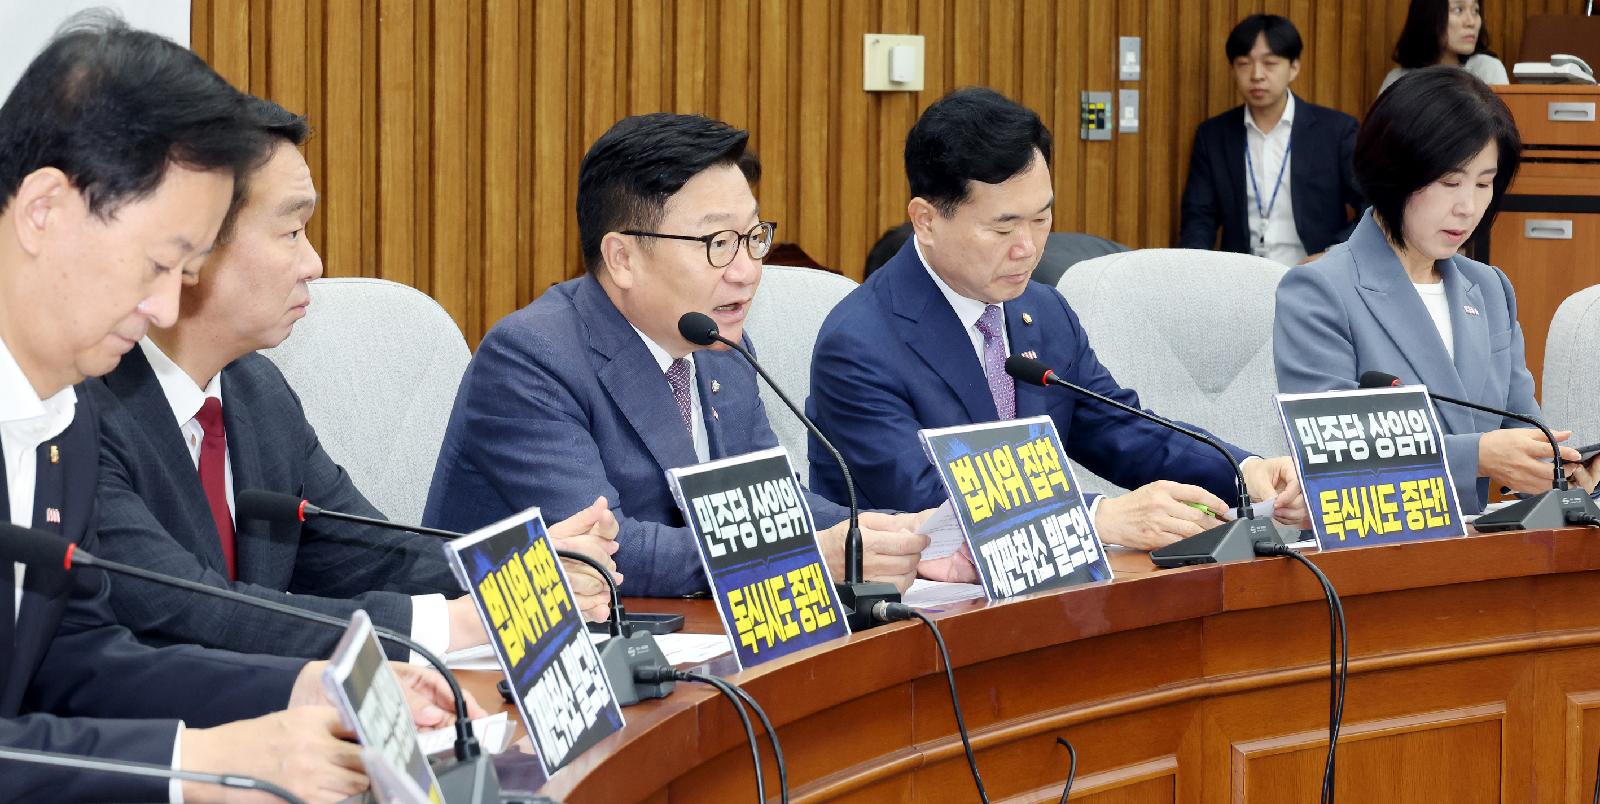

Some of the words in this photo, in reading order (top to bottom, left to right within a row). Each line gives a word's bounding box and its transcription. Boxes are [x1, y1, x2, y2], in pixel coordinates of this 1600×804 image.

[949, 444, 1032, 524] 법사위
[1015, 436, 1071, 502] 집착
[1295, 413, 1370, 464] 민주당
[1367, 408, 1438, 459] 상임위
[691, 487, 758, 558] 민주당
[748, 476, 810, 544] 상임위
[979, 523, 1056, 598] 재판취소
[1041, 505, 1100, 578] 빌드업
[1320, 484, 1403, 541] 독식시도
[1399, 476, 1451, 531] 중단!
[479, 552, 549, 667] 법사위
[523, 537, 571, 625] 집착
[727, 575, 800, 654] 독식시도
[787, 563, 836, 632] 중단!
[523, 660, 585, 767] 재판취소
[560, 628, 611, 728] 빌드업
